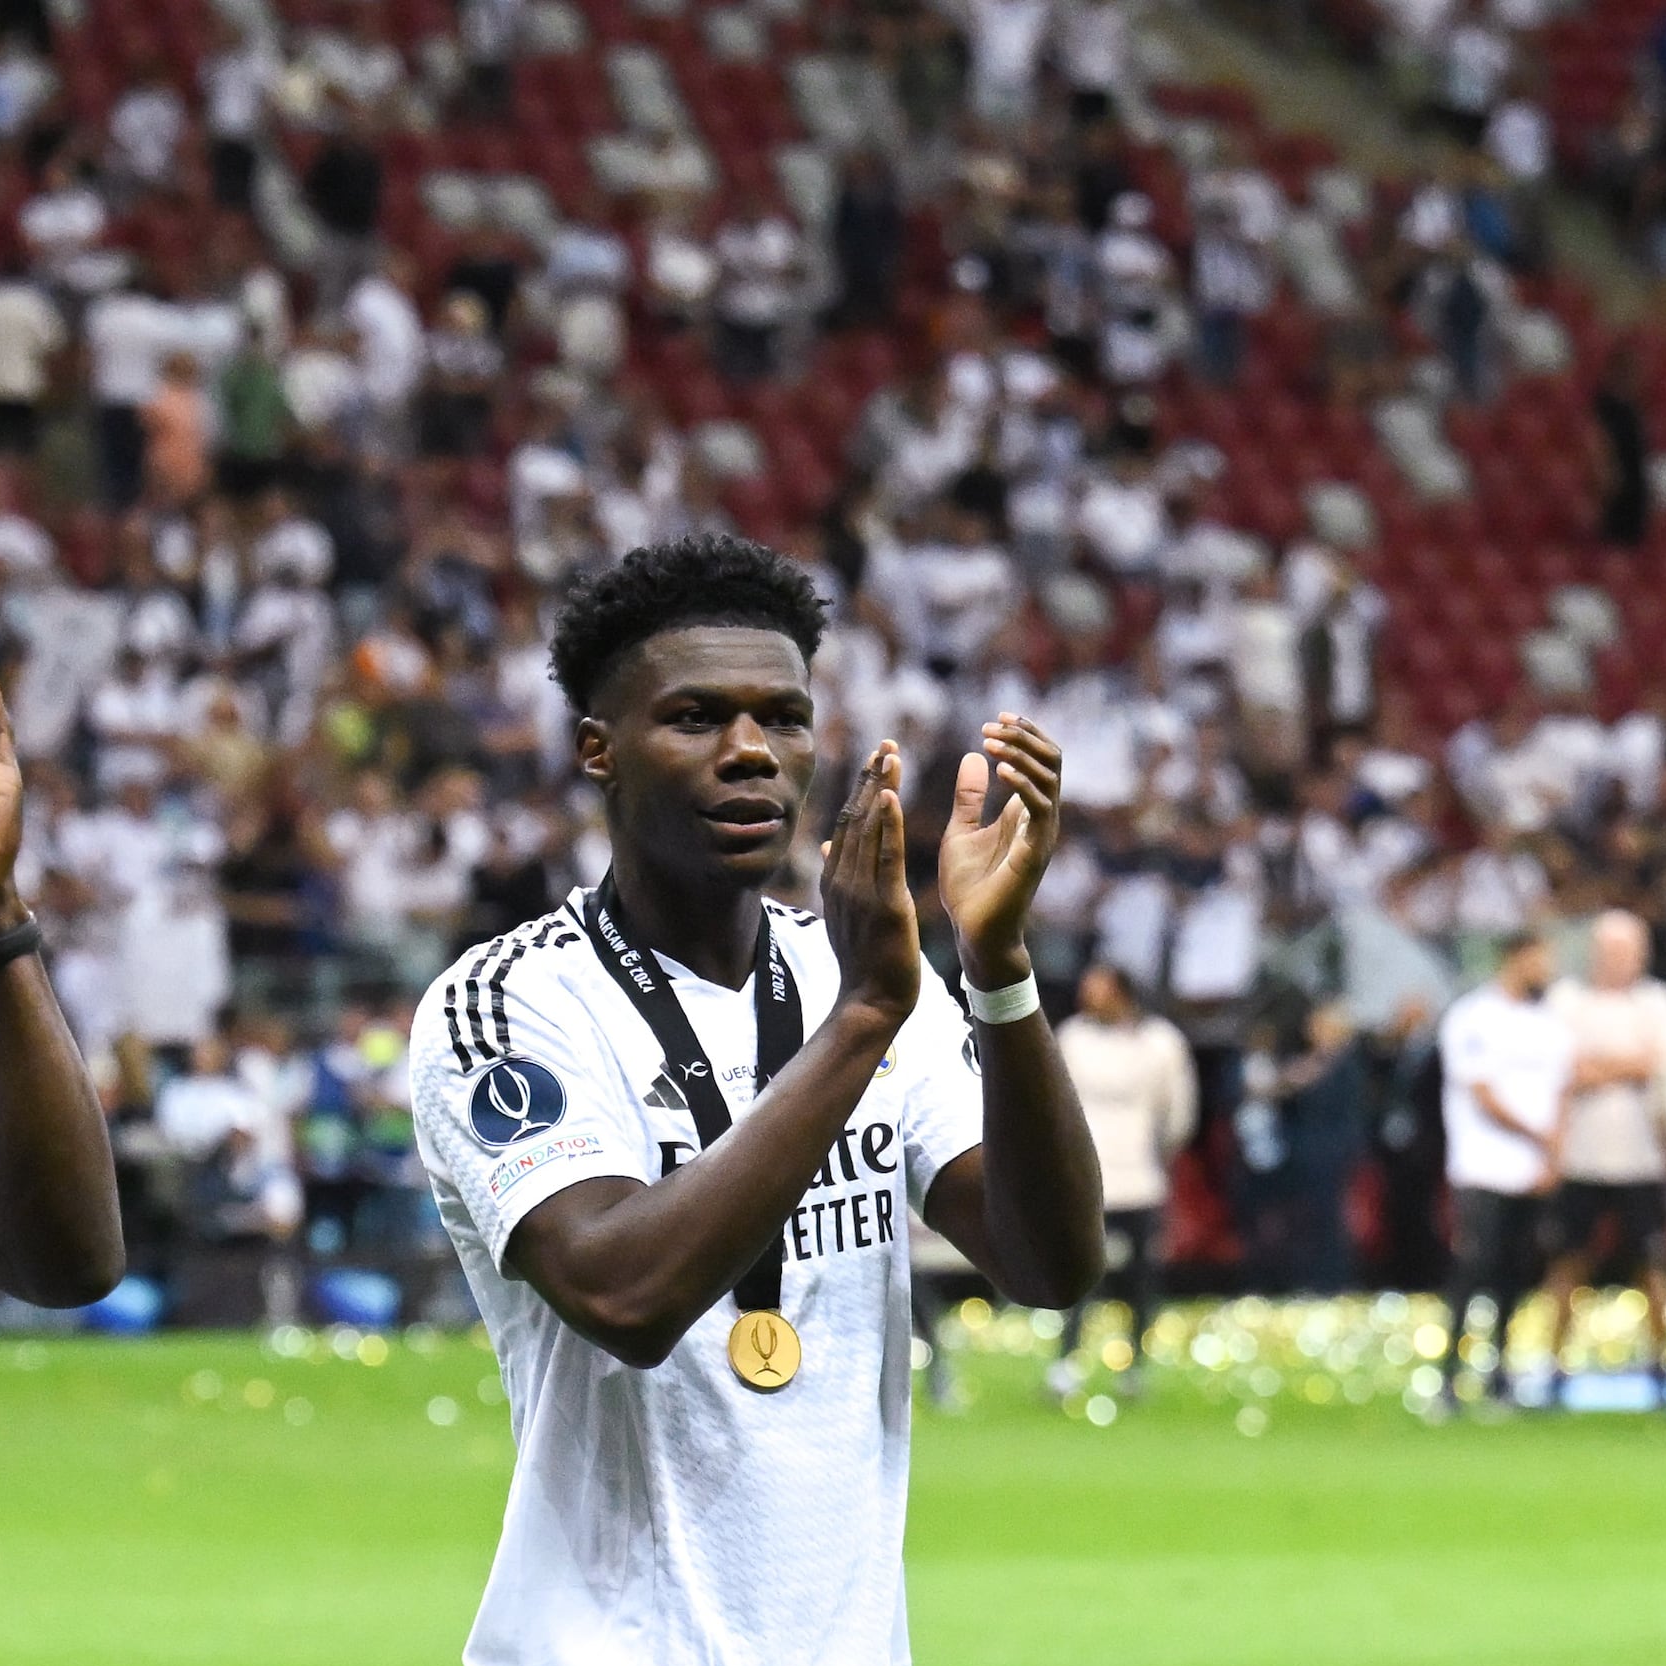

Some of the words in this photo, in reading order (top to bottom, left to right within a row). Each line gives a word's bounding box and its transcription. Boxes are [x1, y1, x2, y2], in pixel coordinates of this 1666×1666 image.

[629, 966, 656, 993] 2024
[772, 974, 787, 1002] 2024
[491, 1136, 601, 1196] FOUNDATION
[783, 1189, 894, 1263] ETTER
